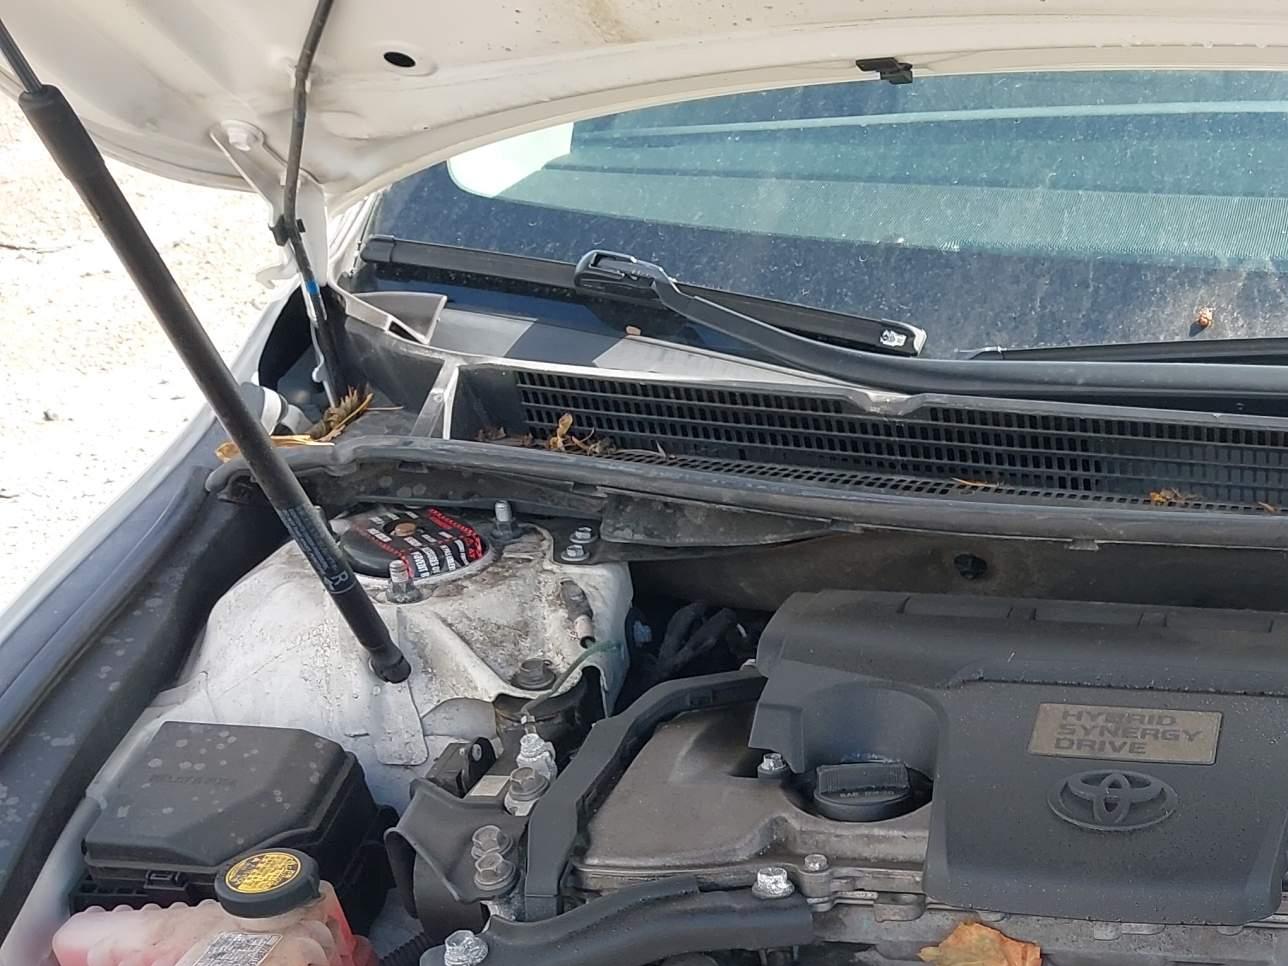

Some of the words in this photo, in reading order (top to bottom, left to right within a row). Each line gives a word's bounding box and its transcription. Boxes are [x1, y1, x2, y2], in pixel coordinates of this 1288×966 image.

[331, 571, 348, 586] R
[1061, 710, 1176, 726] HYBRID
[1057, 724, 1203, 742] SYNERGY
[1054, 737, 1147, 754] DRIVE
